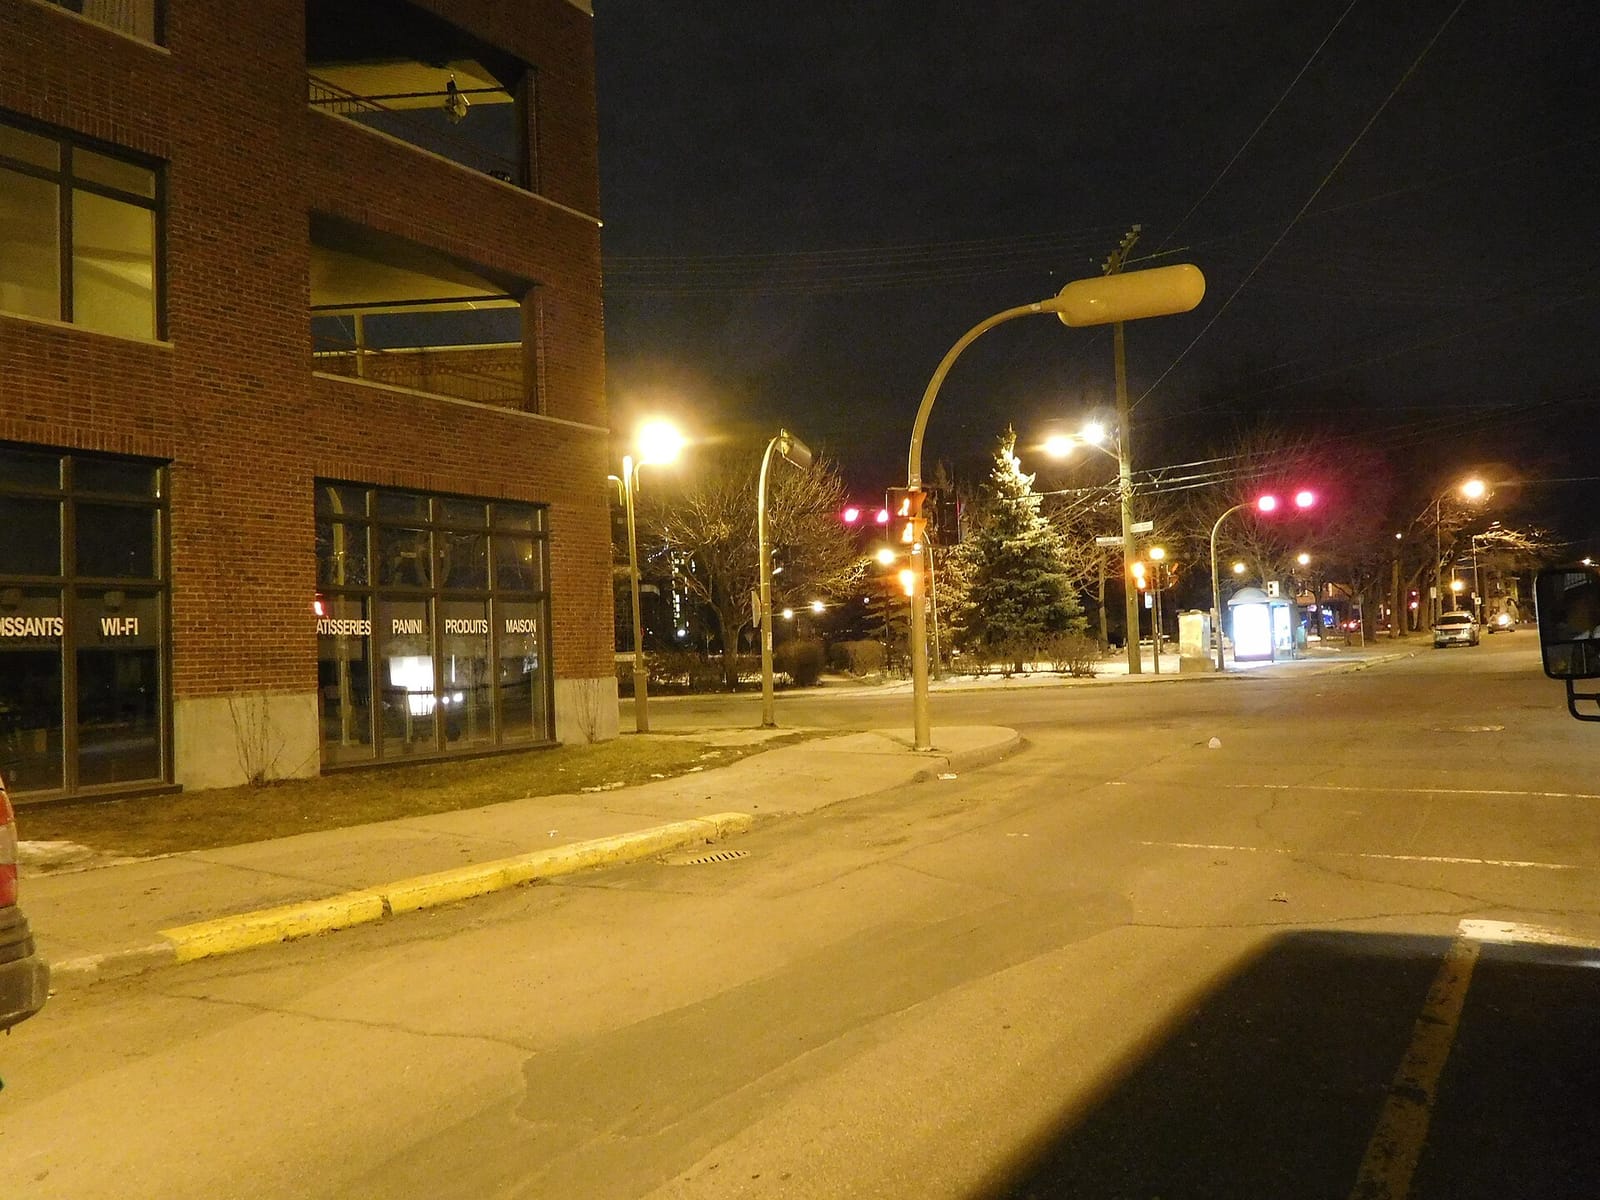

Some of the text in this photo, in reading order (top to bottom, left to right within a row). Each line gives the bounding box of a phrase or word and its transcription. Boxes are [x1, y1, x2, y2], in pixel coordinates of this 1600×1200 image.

[0, 617, 139, 636] ISSANTS WI-FI
[316, 619, 537, 635] ATISSERIES PANINI PRODUITS MAISON
